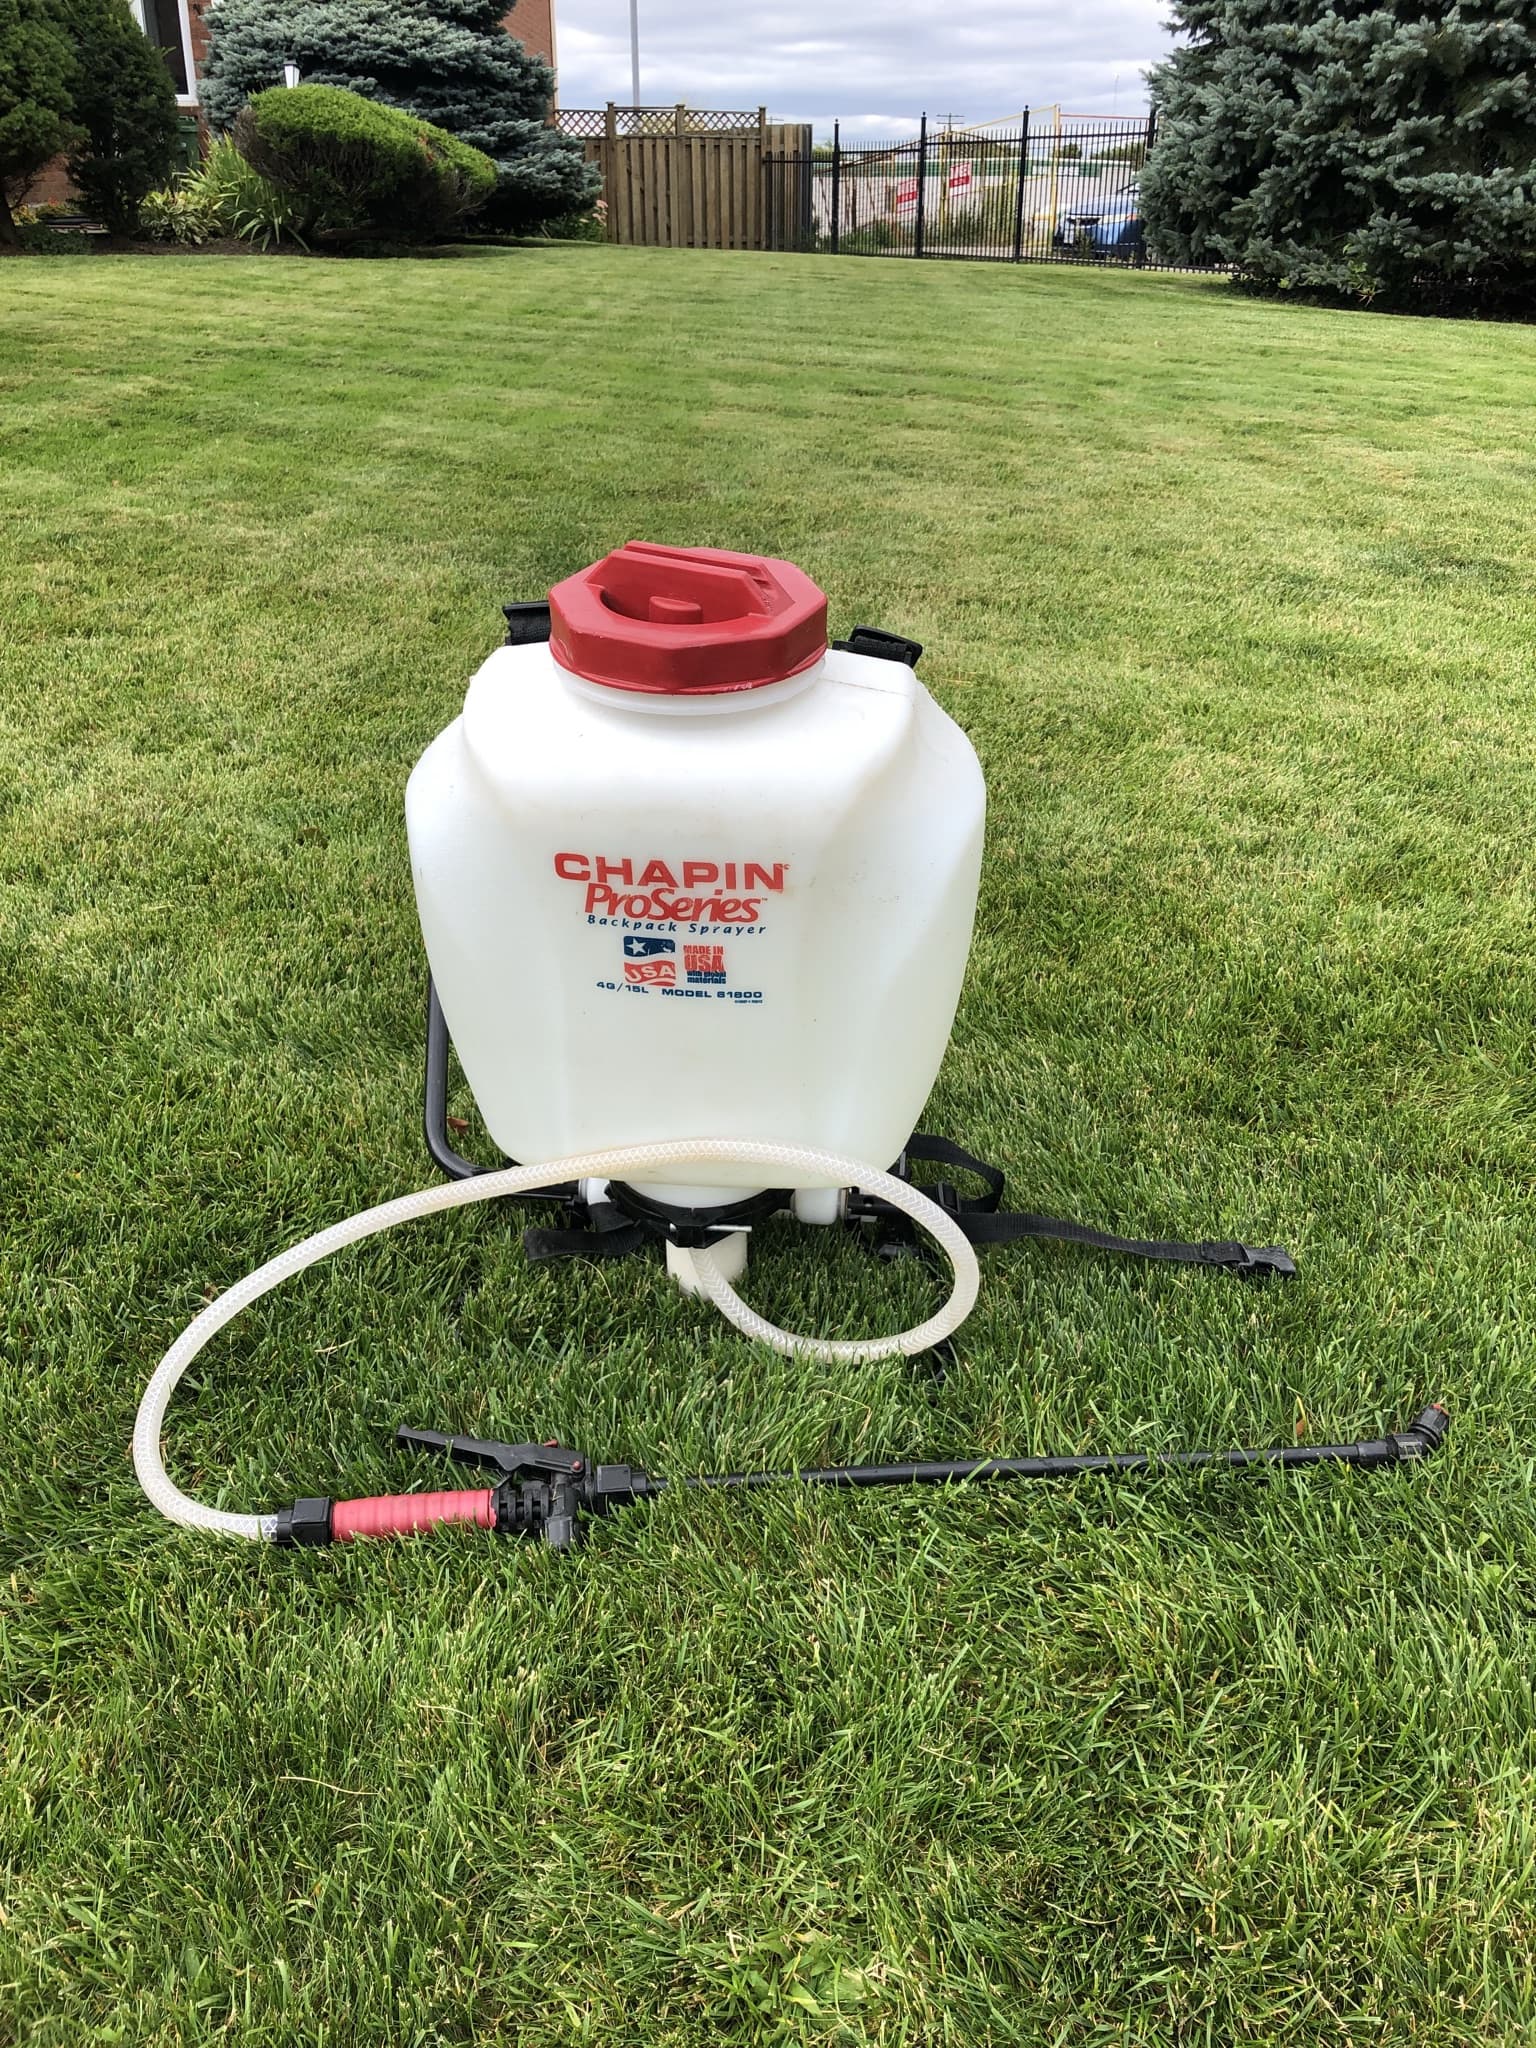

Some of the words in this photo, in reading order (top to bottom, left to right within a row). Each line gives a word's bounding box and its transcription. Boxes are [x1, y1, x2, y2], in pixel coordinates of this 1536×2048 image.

[554, 852, 785, 891] CHAPIN
[585, 883, 762, 923] ProSeries
[587, 914, 677, 932] Backpack
[688, 923, 767, 937] Sprayer
[683, 945, 711, 955] MADE
[713, 946, 724, 955] IN
[684, 954, 725, 972] USA
[625, 965, 674, 982] USA
[596, 981, 649, 994] 4G/15L
[662, 988, 712, 998] MODEL
[717, 991, 763, 999] 61800
